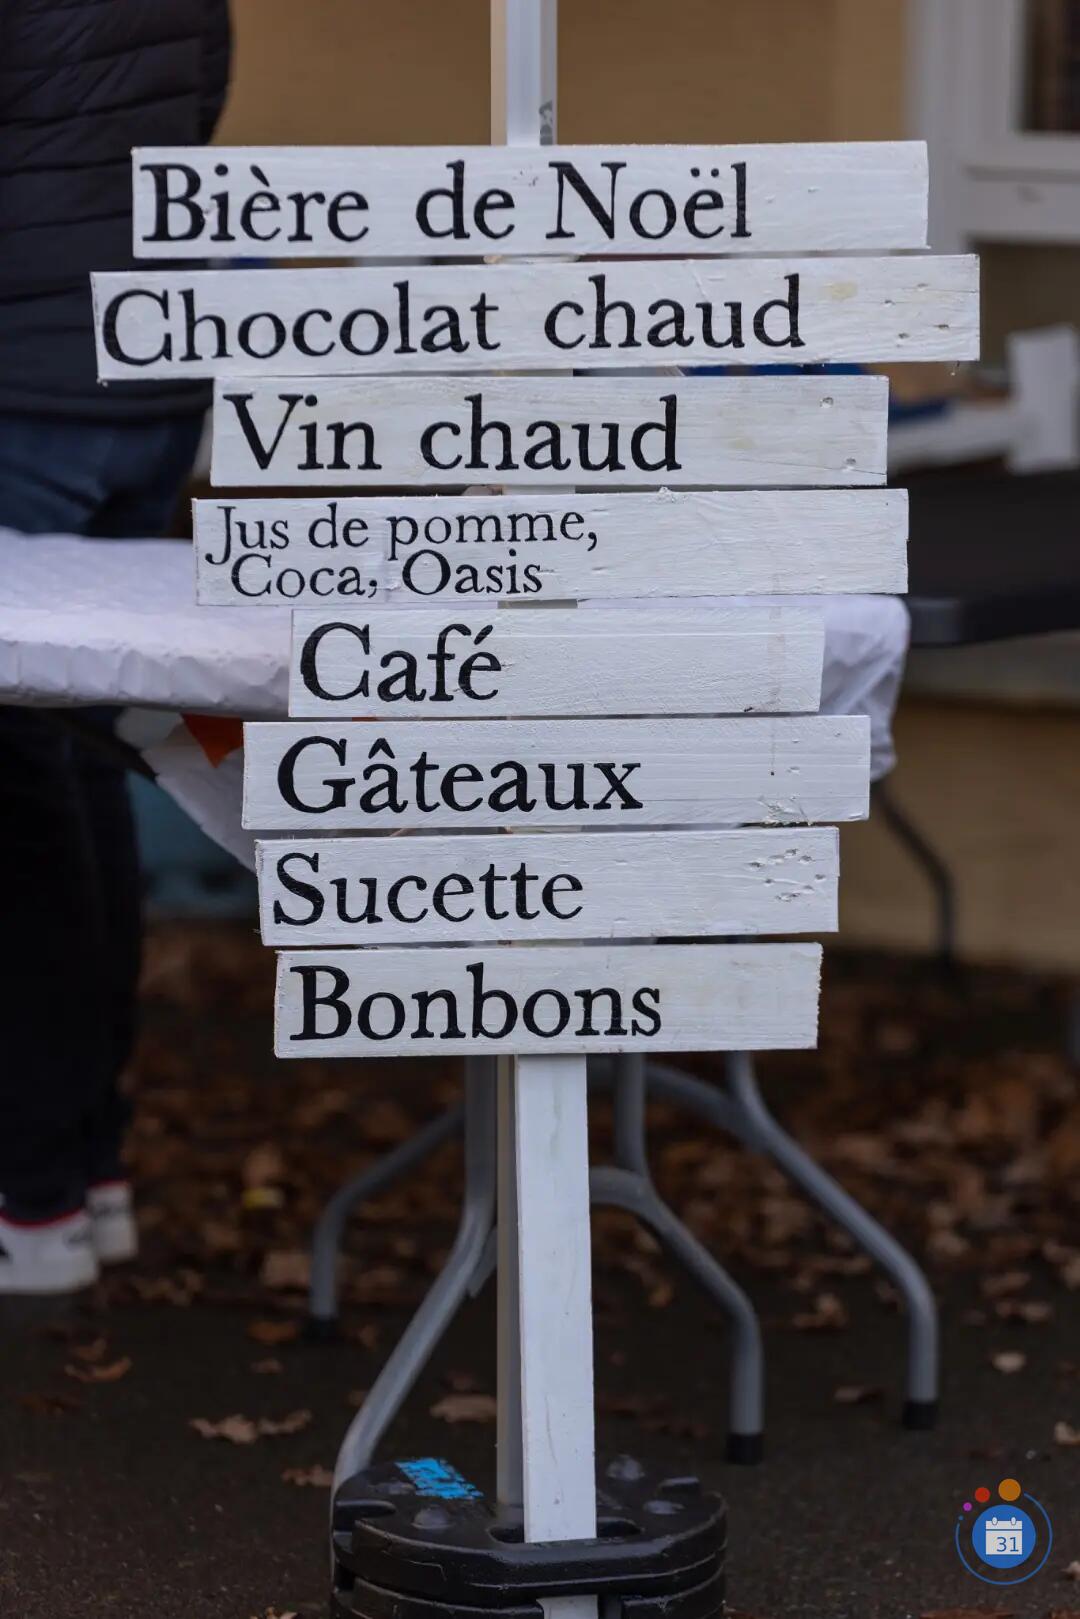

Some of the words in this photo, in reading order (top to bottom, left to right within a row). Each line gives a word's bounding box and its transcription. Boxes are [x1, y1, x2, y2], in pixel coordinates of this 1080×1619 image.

[141, 162, 370, 243] Bière
[415, 159, 515, 240] de
[545, 160, 753, 240] Noël
[102, 280, 501, 367] Chocolat
[544, 273, 806, 350] chaud
[223, 393, 384, 471] Vin
[420, 393, 683, 473] chaud
[204, 506, 290, 567] Jus
[308, 502, 369, 548] de
[385, 511, 599, 562] pomme,
[231, 553, 379, 599] Coca,
[402, 548, 543, 596] Oasis
[300, 621, 503, 703] Café
[277, 735, 644, 814] Gâteaux
[272, 852, 584, 926] Sucette
[289, 961, 662, 1041] Bonbons
